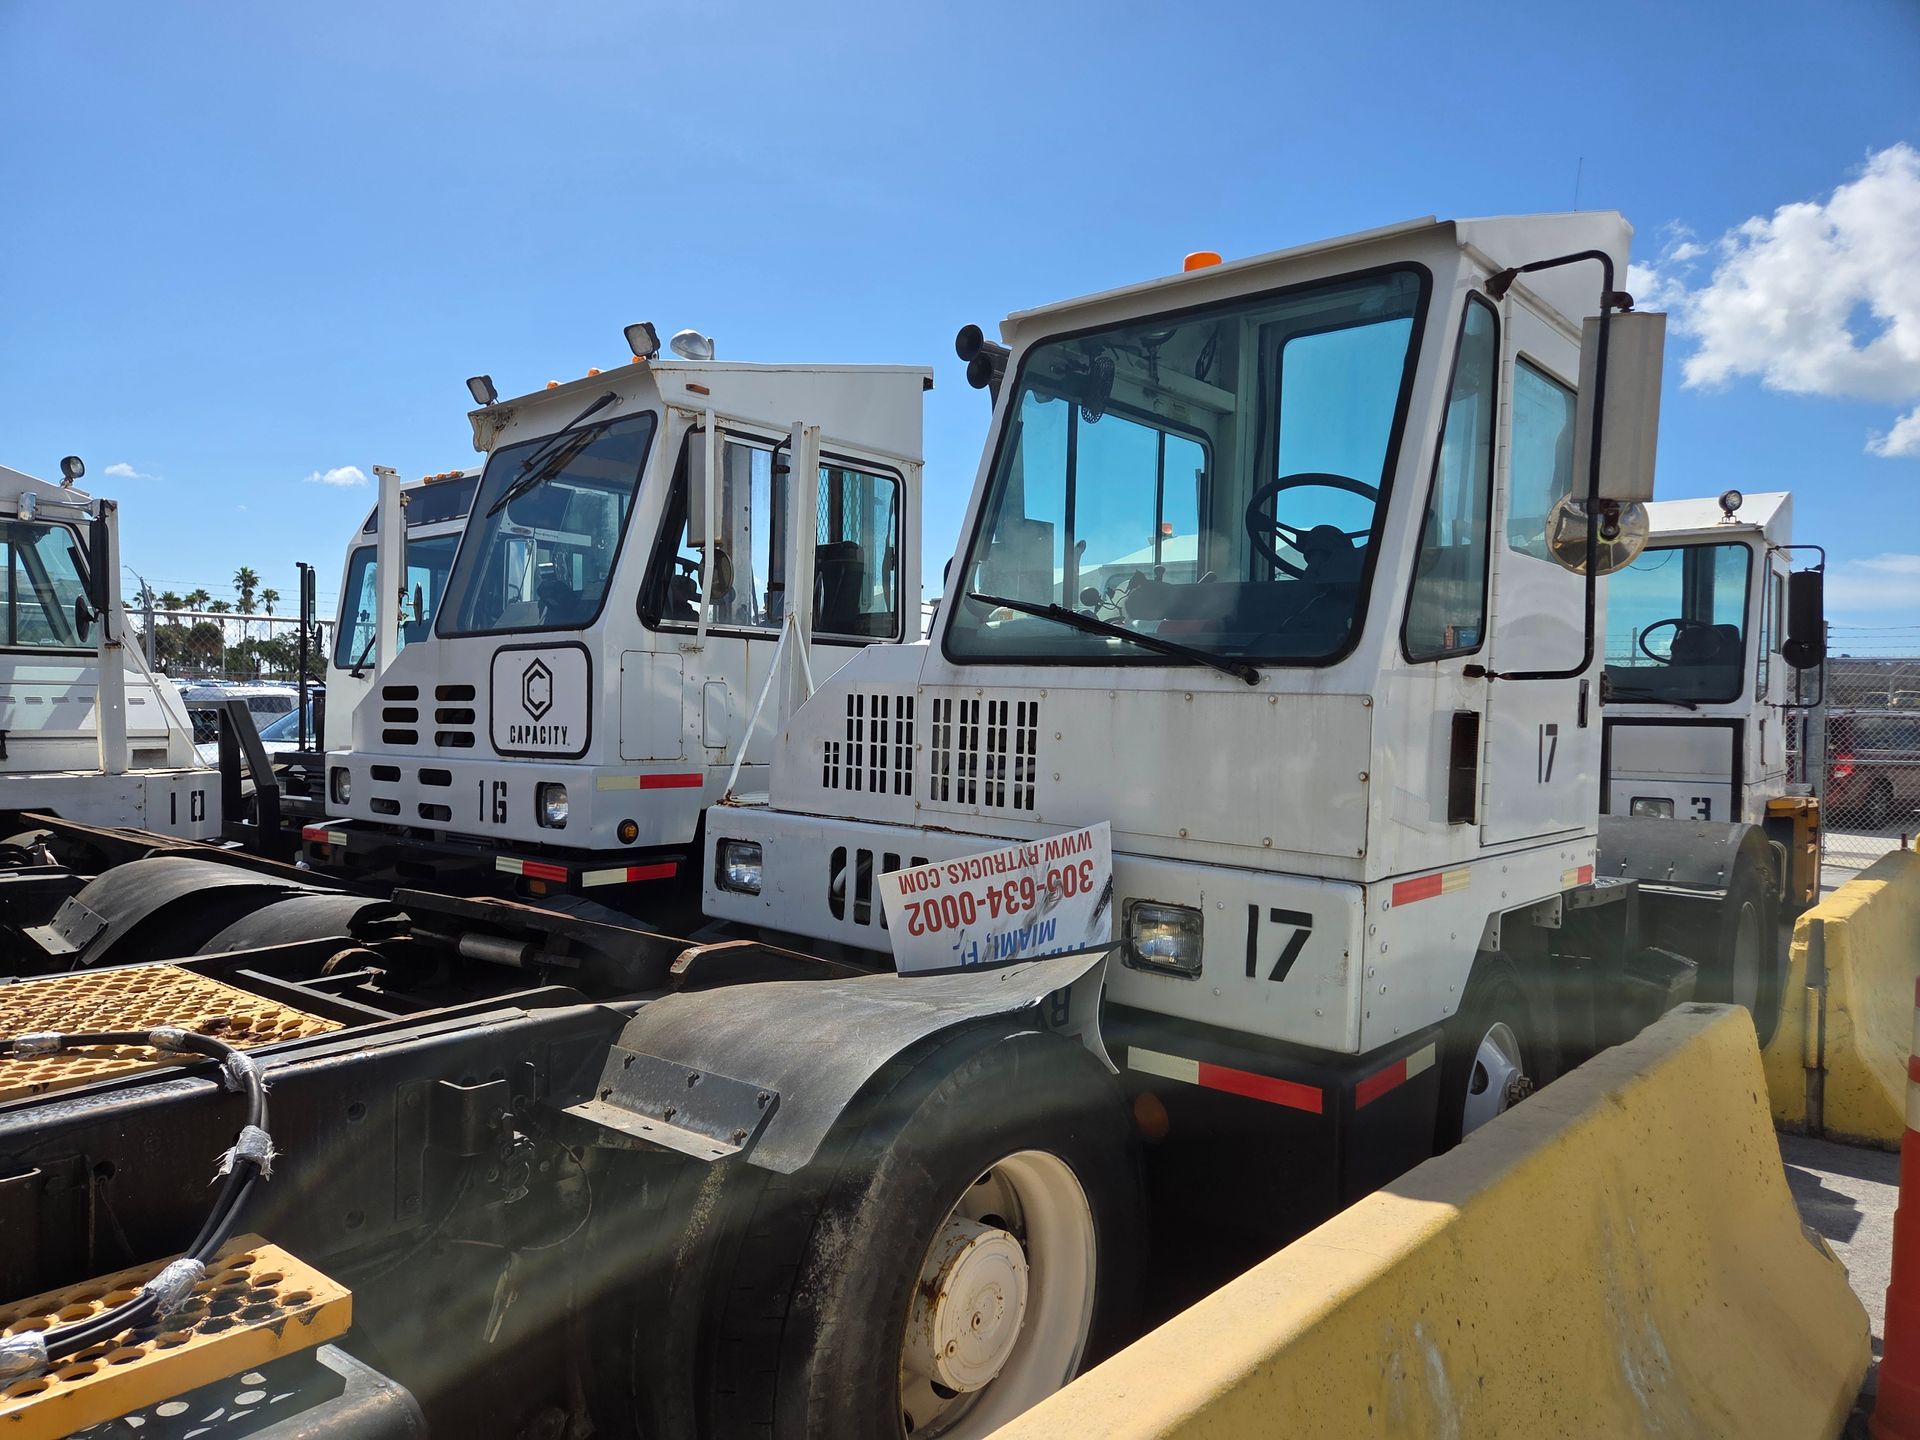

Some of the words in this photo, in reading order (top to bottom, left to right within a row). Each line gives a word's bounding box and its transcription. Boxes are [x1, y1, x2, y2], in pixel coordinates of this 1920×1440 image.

[509, 724, 568, 746] CAPACITY
[1538, 723, 1558, 784] 17
[170, 789, 205, 825] 10
[478, 780, 508, 824] 16
[1690, 797, 1712, 821] 3
[897, 830, 1093, 896] WWW.RYTRUCKS.COM
[903, 859, 1094, 937] 305-634-0002
[985, 917, 1057, 961] MIAMI,
[1245, 903, 1313, 983] 17
